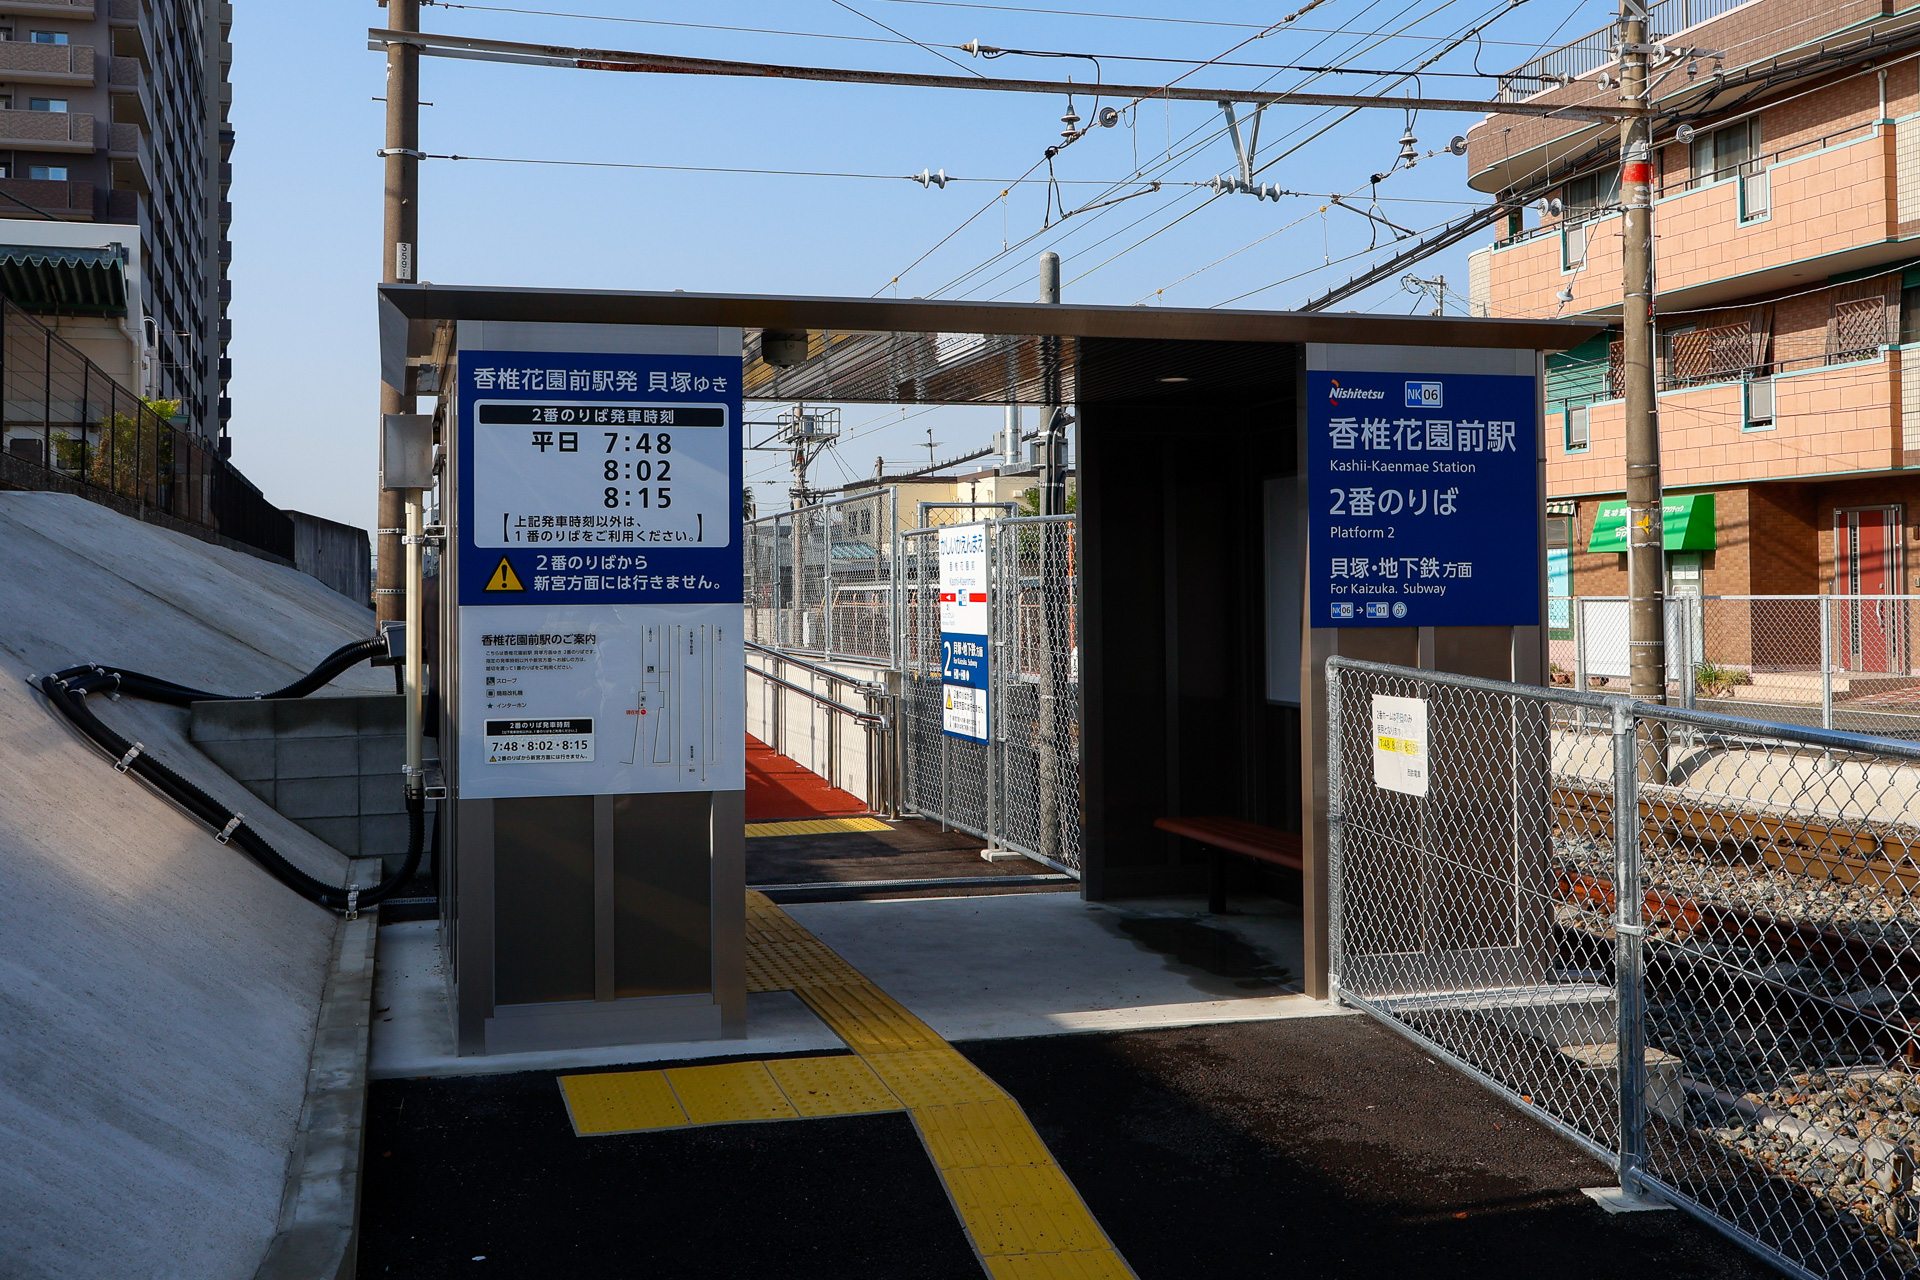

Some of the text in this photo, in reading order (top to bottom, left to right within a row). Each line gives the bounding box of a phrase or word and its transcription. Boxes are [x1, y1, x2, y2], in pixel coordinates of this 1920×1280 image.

[473, 368, 728, 393] 香椎花園前駅発 貝塚ゆき
[1329, 387, 1439, 400] Nishitetsu NK 06
[532, 408, 675, 424] 2番のりば発車時刻
[531, 431, 672, 454] 平日 7:48
[1328, 417, 1517, 452] 香椎花園前駅
[603, 460, 672, 482] 8:02
[1330, 460, 1476, 473] Kashii-Kaenmae Station
[603, 487, 672, 509] 8:15
[1329, 486, 1460, 516] 2番のりば
[1330, 526, 1395, 539] Platform 2
[535, 554, 649, 571] 2番のりばから
[533, 574, 721, 591] 新宮方面には行きません。
[1330, 584, 1348, 594] For
[1403, 583, 1447, 596] Subway
[481, 633, 596, 646] 香椎花園前駅のご案内
[943, 640, 952, 677] 2
[509, 721, 571, 729] 2番のりば発車時刻
